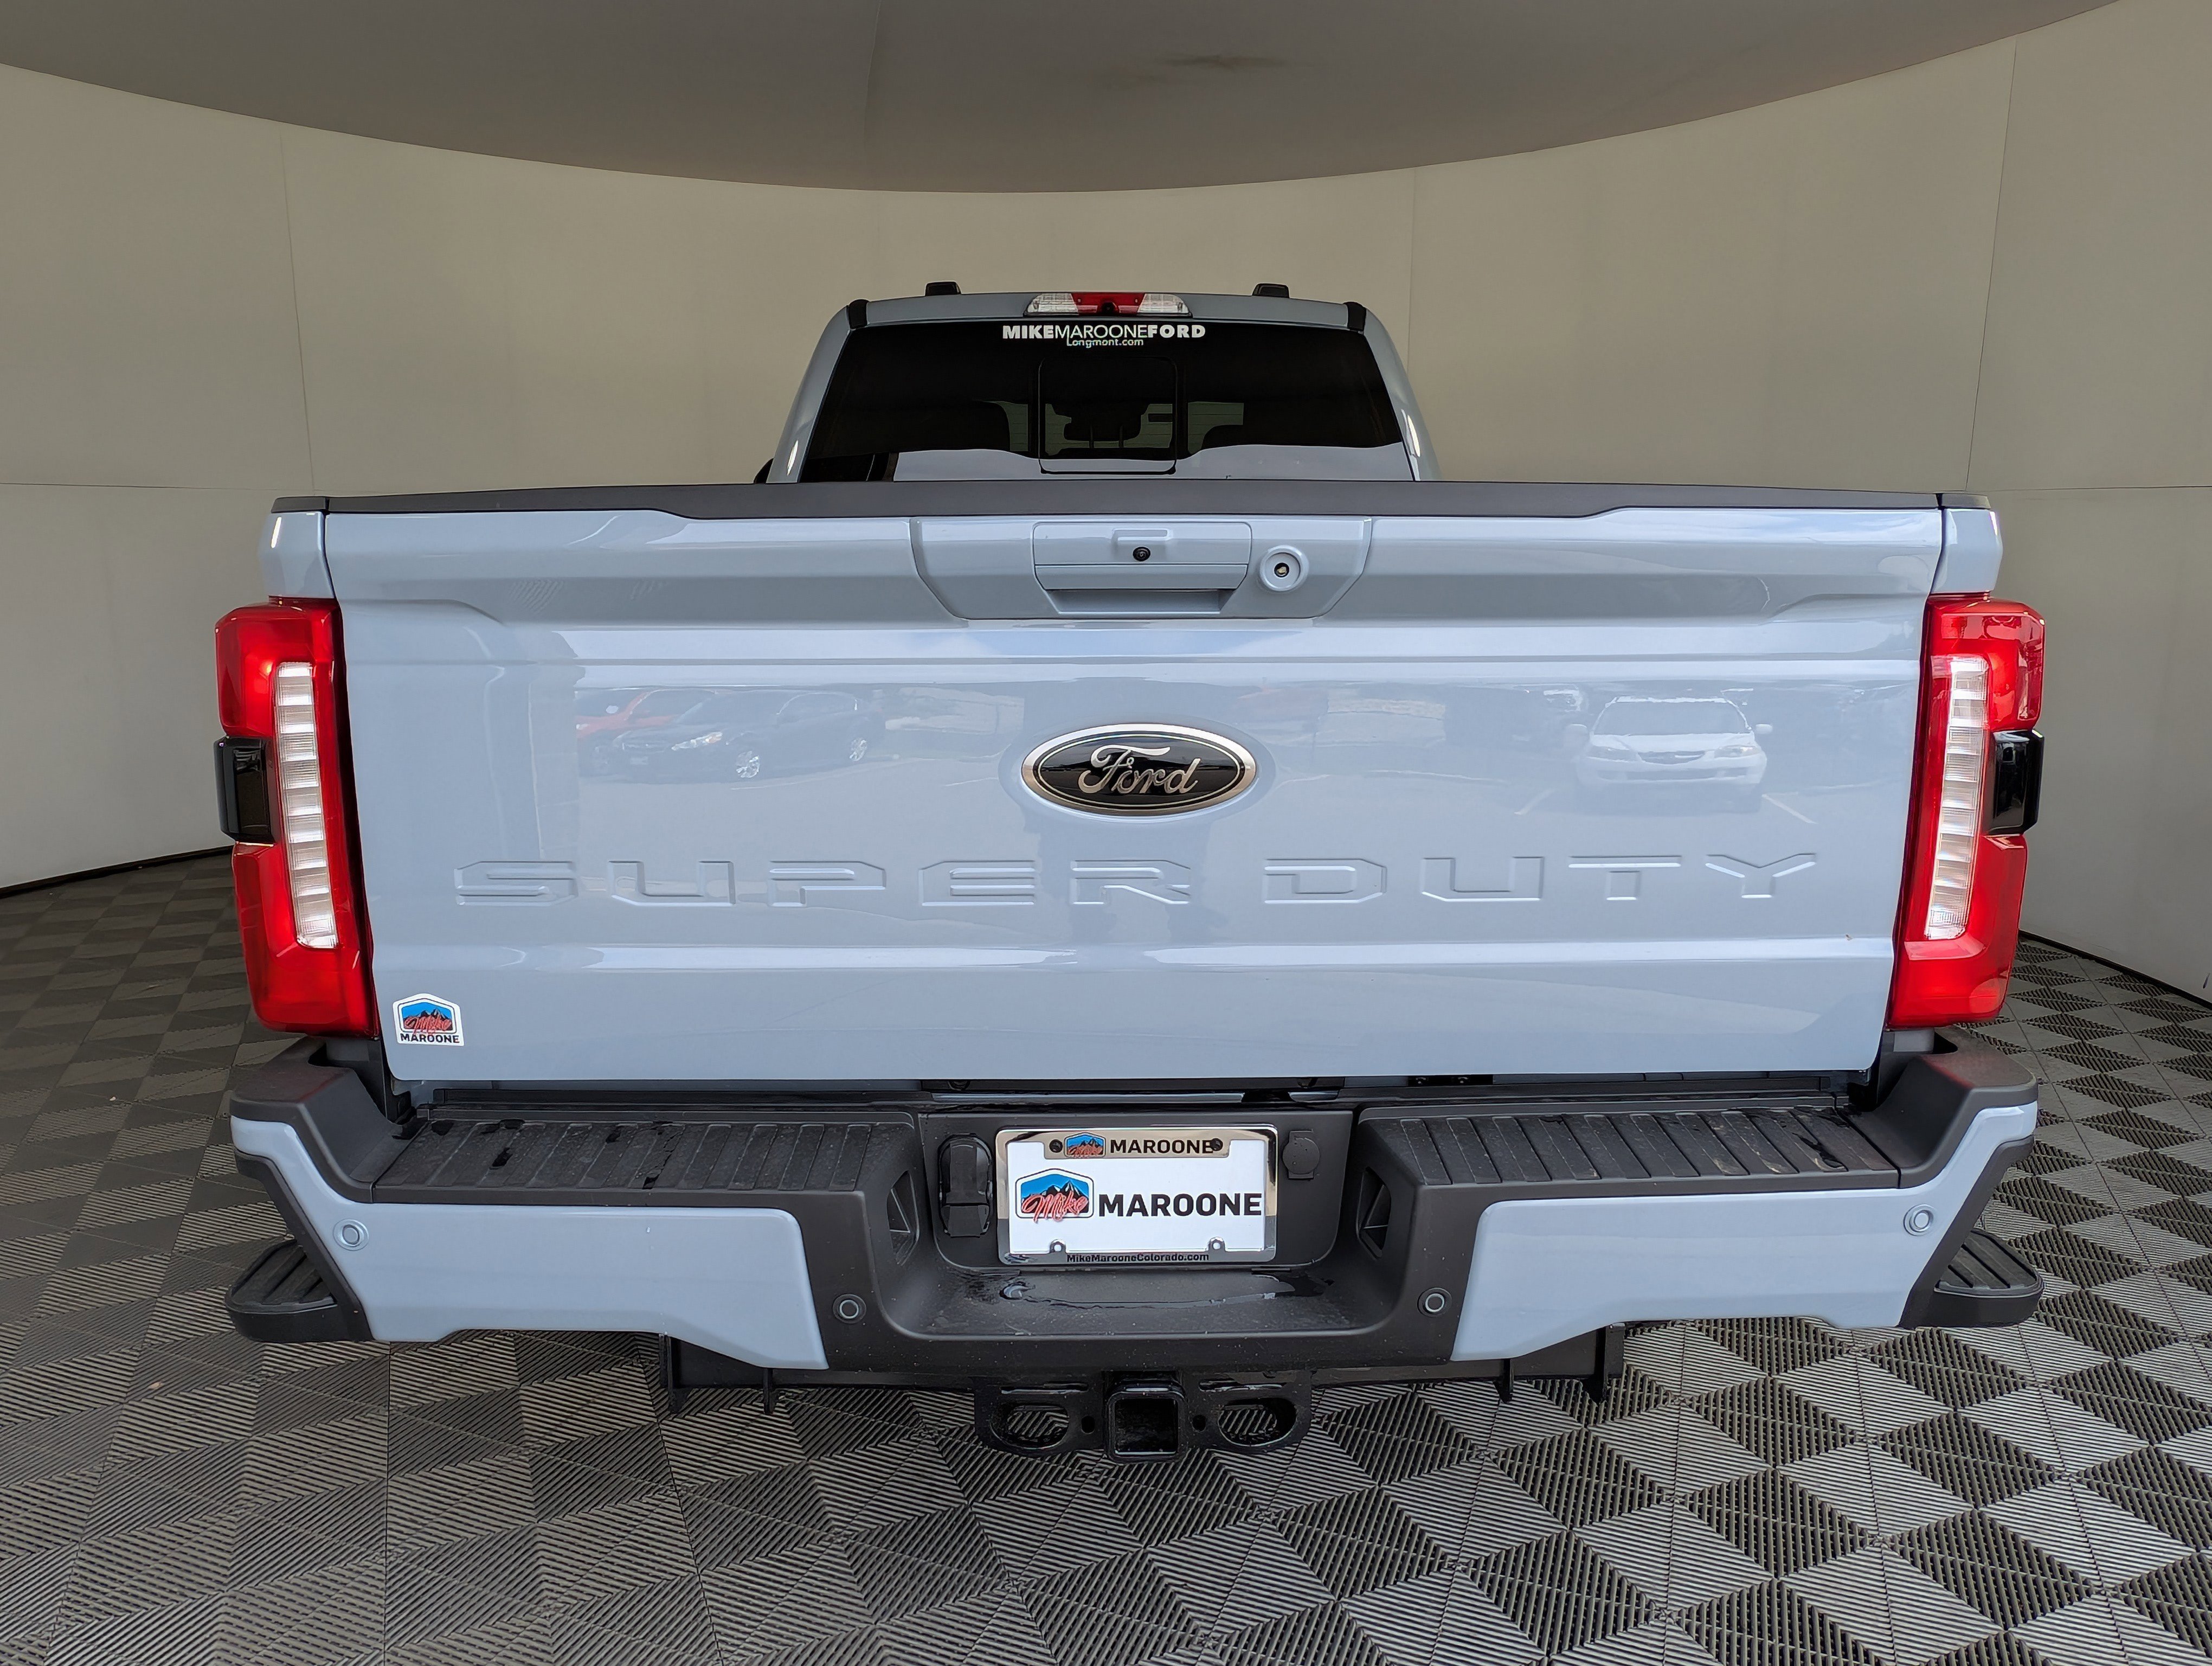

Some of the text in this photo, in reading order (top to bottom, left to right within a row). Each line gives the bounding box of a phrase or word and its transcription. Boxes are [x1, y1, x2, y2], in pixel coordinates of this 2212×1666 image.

[1066, 337, 1144, 348] Longmont.com
[1078, 744, 1201, 794] Ford
[454, 854, 1817, 906] SUPER DUTY
[400, 1033, 460, 1043] MAROONE
[1110, 1139, 1213, 1154] MAROONE
[1022, 1191, 1262, 1223] Mike MAROONE
[1066, 1253, 1209, 1262] MikeMarooneColorado.com
